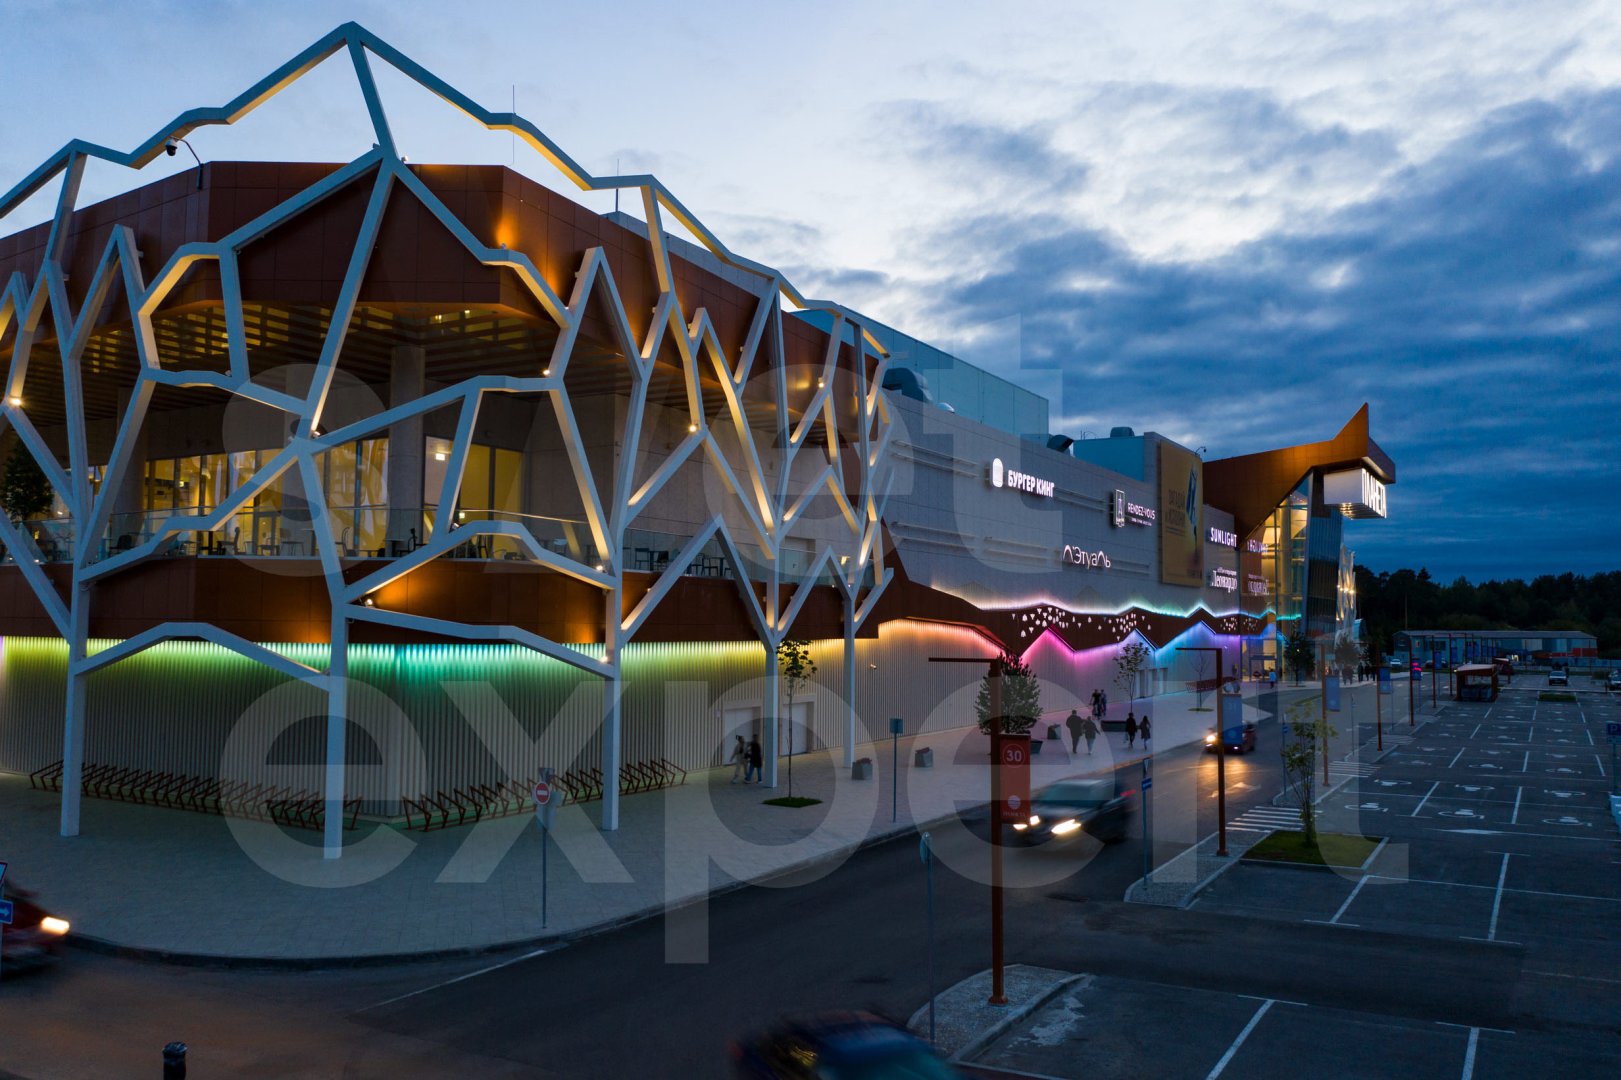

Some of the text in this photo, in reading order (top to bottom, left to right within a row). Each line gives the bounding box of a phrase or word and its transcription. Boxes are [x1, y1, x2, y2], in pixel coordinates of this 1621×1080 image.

[1008, 469, 1055, 498] БУРГЕР КИНГ
[1210, 527, 1238, 548] SUNLIGHT
[1006, 750, 1022, 762] 30
